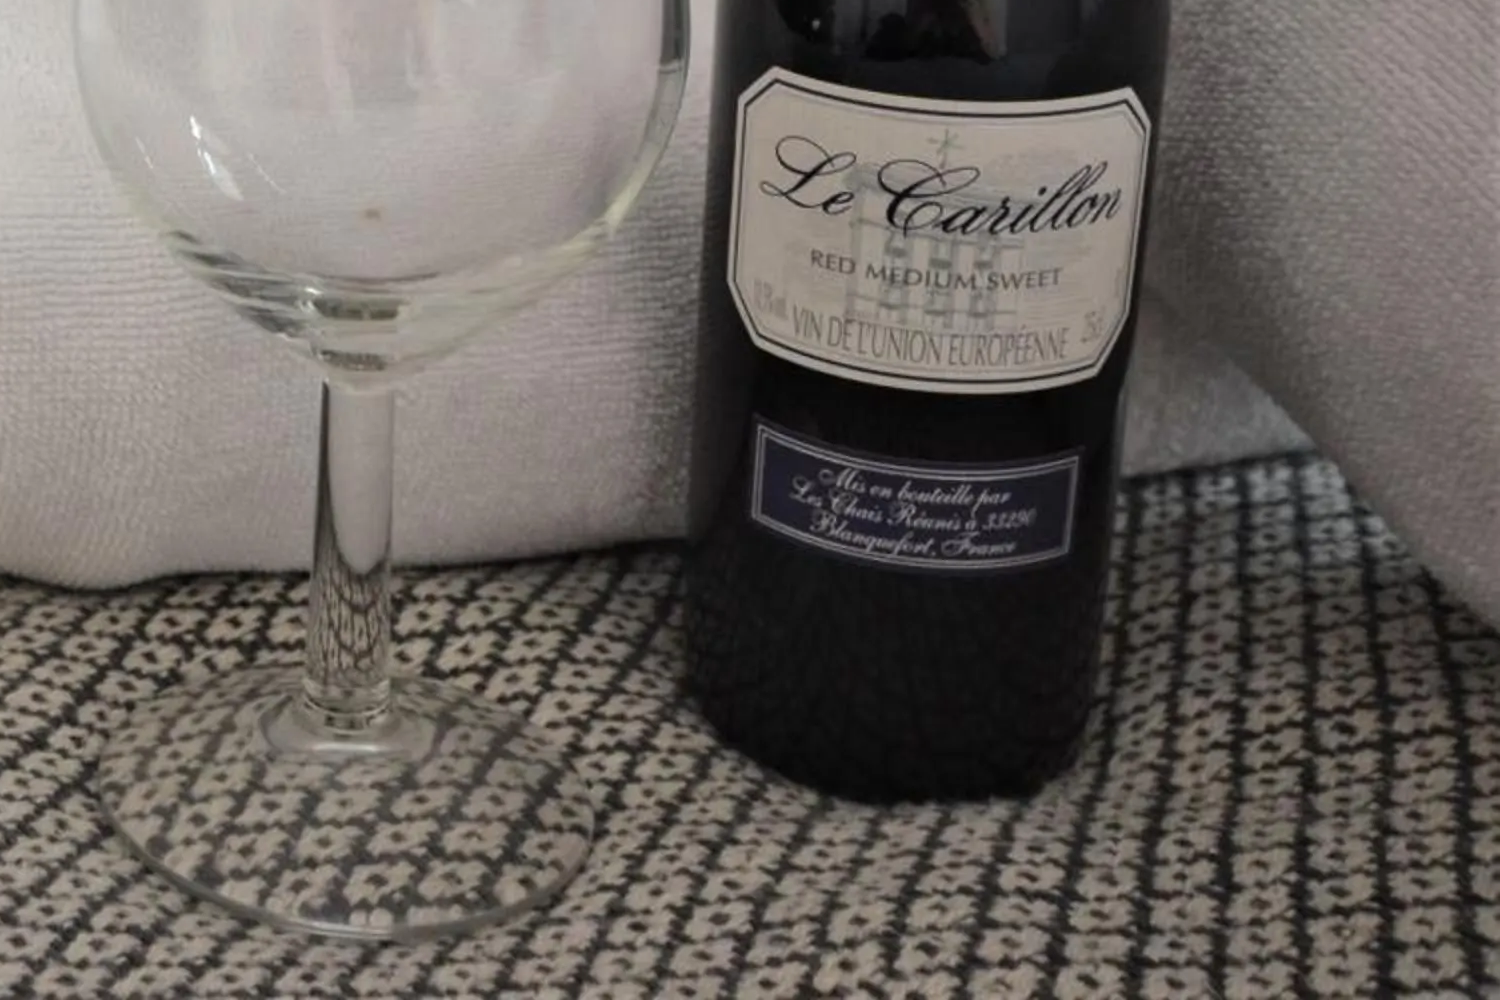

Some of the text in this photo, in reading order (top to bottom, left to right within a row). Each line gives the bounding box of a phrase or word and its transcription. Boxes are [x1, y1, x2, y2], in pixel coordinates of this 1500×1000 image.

[759, 135, 1122, 238] Le Carillon
[810, 248, 1065, 290] RED MEDIUM SWEET
[793, 303, 823, 343] VIN
[827, 315, 854, 351] DE
[819, 467, 866, 494] Mis
